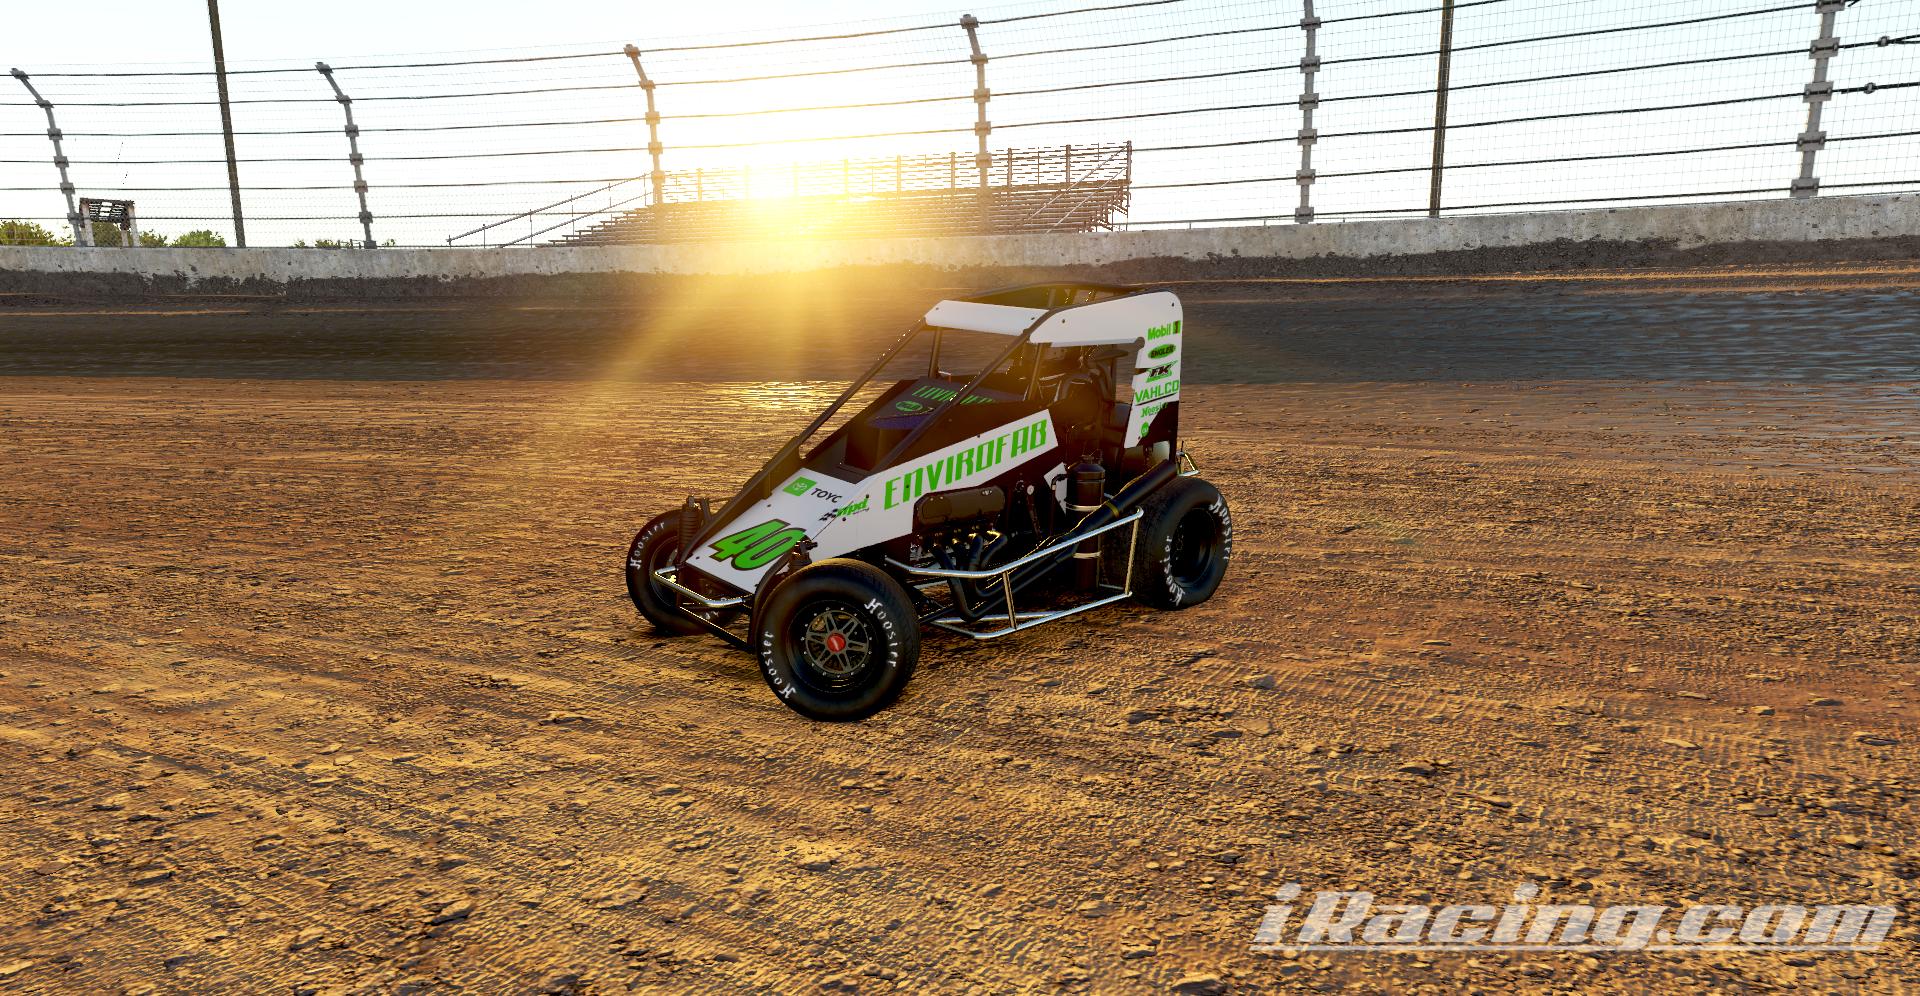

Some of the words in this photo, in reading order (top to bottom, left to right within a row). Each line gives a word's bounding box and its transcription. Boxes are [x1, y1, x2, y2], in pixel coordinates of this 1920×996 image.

[1147, 322, 1172, 340] Mobil
[1135, 380, 1180, 403] VAHLCO
[884, 418, 1048, 510] ENVIROFAB
[629, 521, 666, 570] Hoosier
[708, 518, 807, 571] 40
[1208, 493, 1232, 560] Hoosier
[1160, 535, 1185, 607] Hoosier
[761, 631, 796, 699] Hoosier
[864, 598, 899, 667] Hoosier
